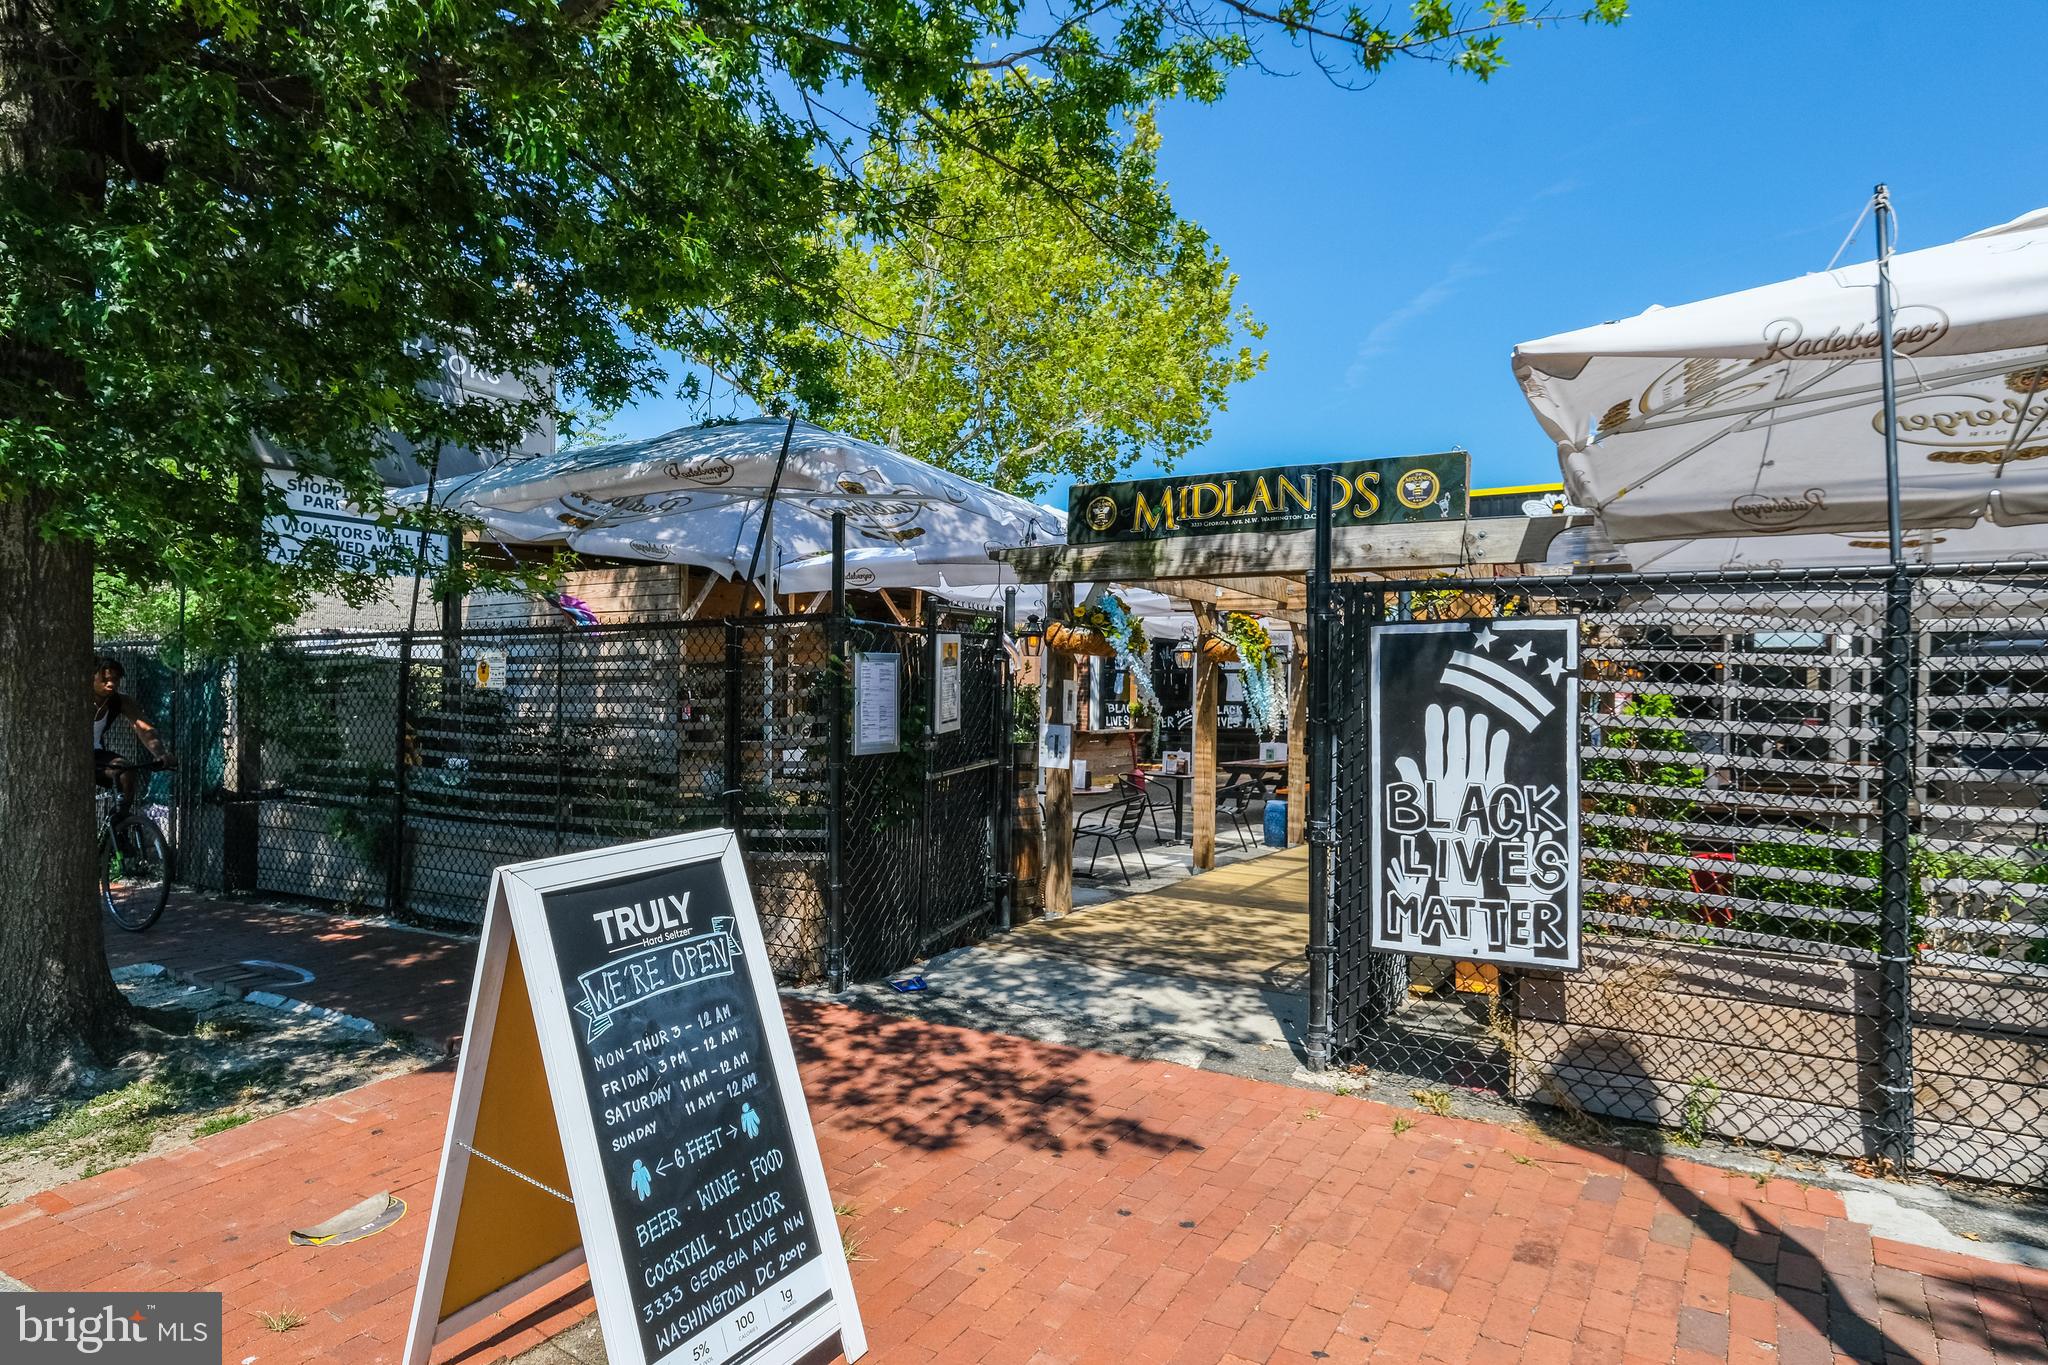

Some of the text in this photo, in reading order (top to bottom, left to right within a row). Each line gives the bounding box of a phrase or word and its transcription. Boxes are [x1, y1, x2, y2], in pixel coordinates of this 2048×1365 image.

[1752, 308, 1946, 366] Radebeger
[1130, 472, 1380, 533] MIDLANDS
[282, 518, 373, 541] VIOLATORS
[1105, 715, 1129, 727] LIVES
[1216, 704, 1243, 715] LACK
[1217, 716, 1241, 729] IVES
[1386, 780, 1566, 839] BLACK
[1400, 834, 1569, 895] LIVES
[593, 891, 690, 944] TRULY
[643, 927, 691, 948] Hard Seltzer
[1386, 890, 1567, 949] MATTER
[584, 937, 729, 1012] WE'RE OPEN
[697, 1010, 712, 1030] 12
[715, 1003, 731, 1024] AM
[601, 1065, 649, 1098] FRIDAY
[657, 1059, 668, 1074] 3
[670, 1050, 687, 1069] PM
[703, 1036, 718, 1052] 12
[721, 1026, 739, 1046] AM
[604, 1084, 671, 1126] SATURDAY
[611, 1120, 657, 1152] SUNDAY
[674, 1127, 723, 1169] 6 FEET
[636, 1148, 784, 1248] BEER WINE FOOD
[644, 1191, 786, 1289] COCKTAIL LIQUOR
[643, 1211, 804, 1324] 3333 GEORGIA AVE NW
[755, 1261, 776, 1287] DC
[779, 1241, 807, 1272] 20010
[780, 1287, 793, 1303] 1g
[735, 1311, 755, 1332] 100
[692, 1340, 710, 1362] 5%
